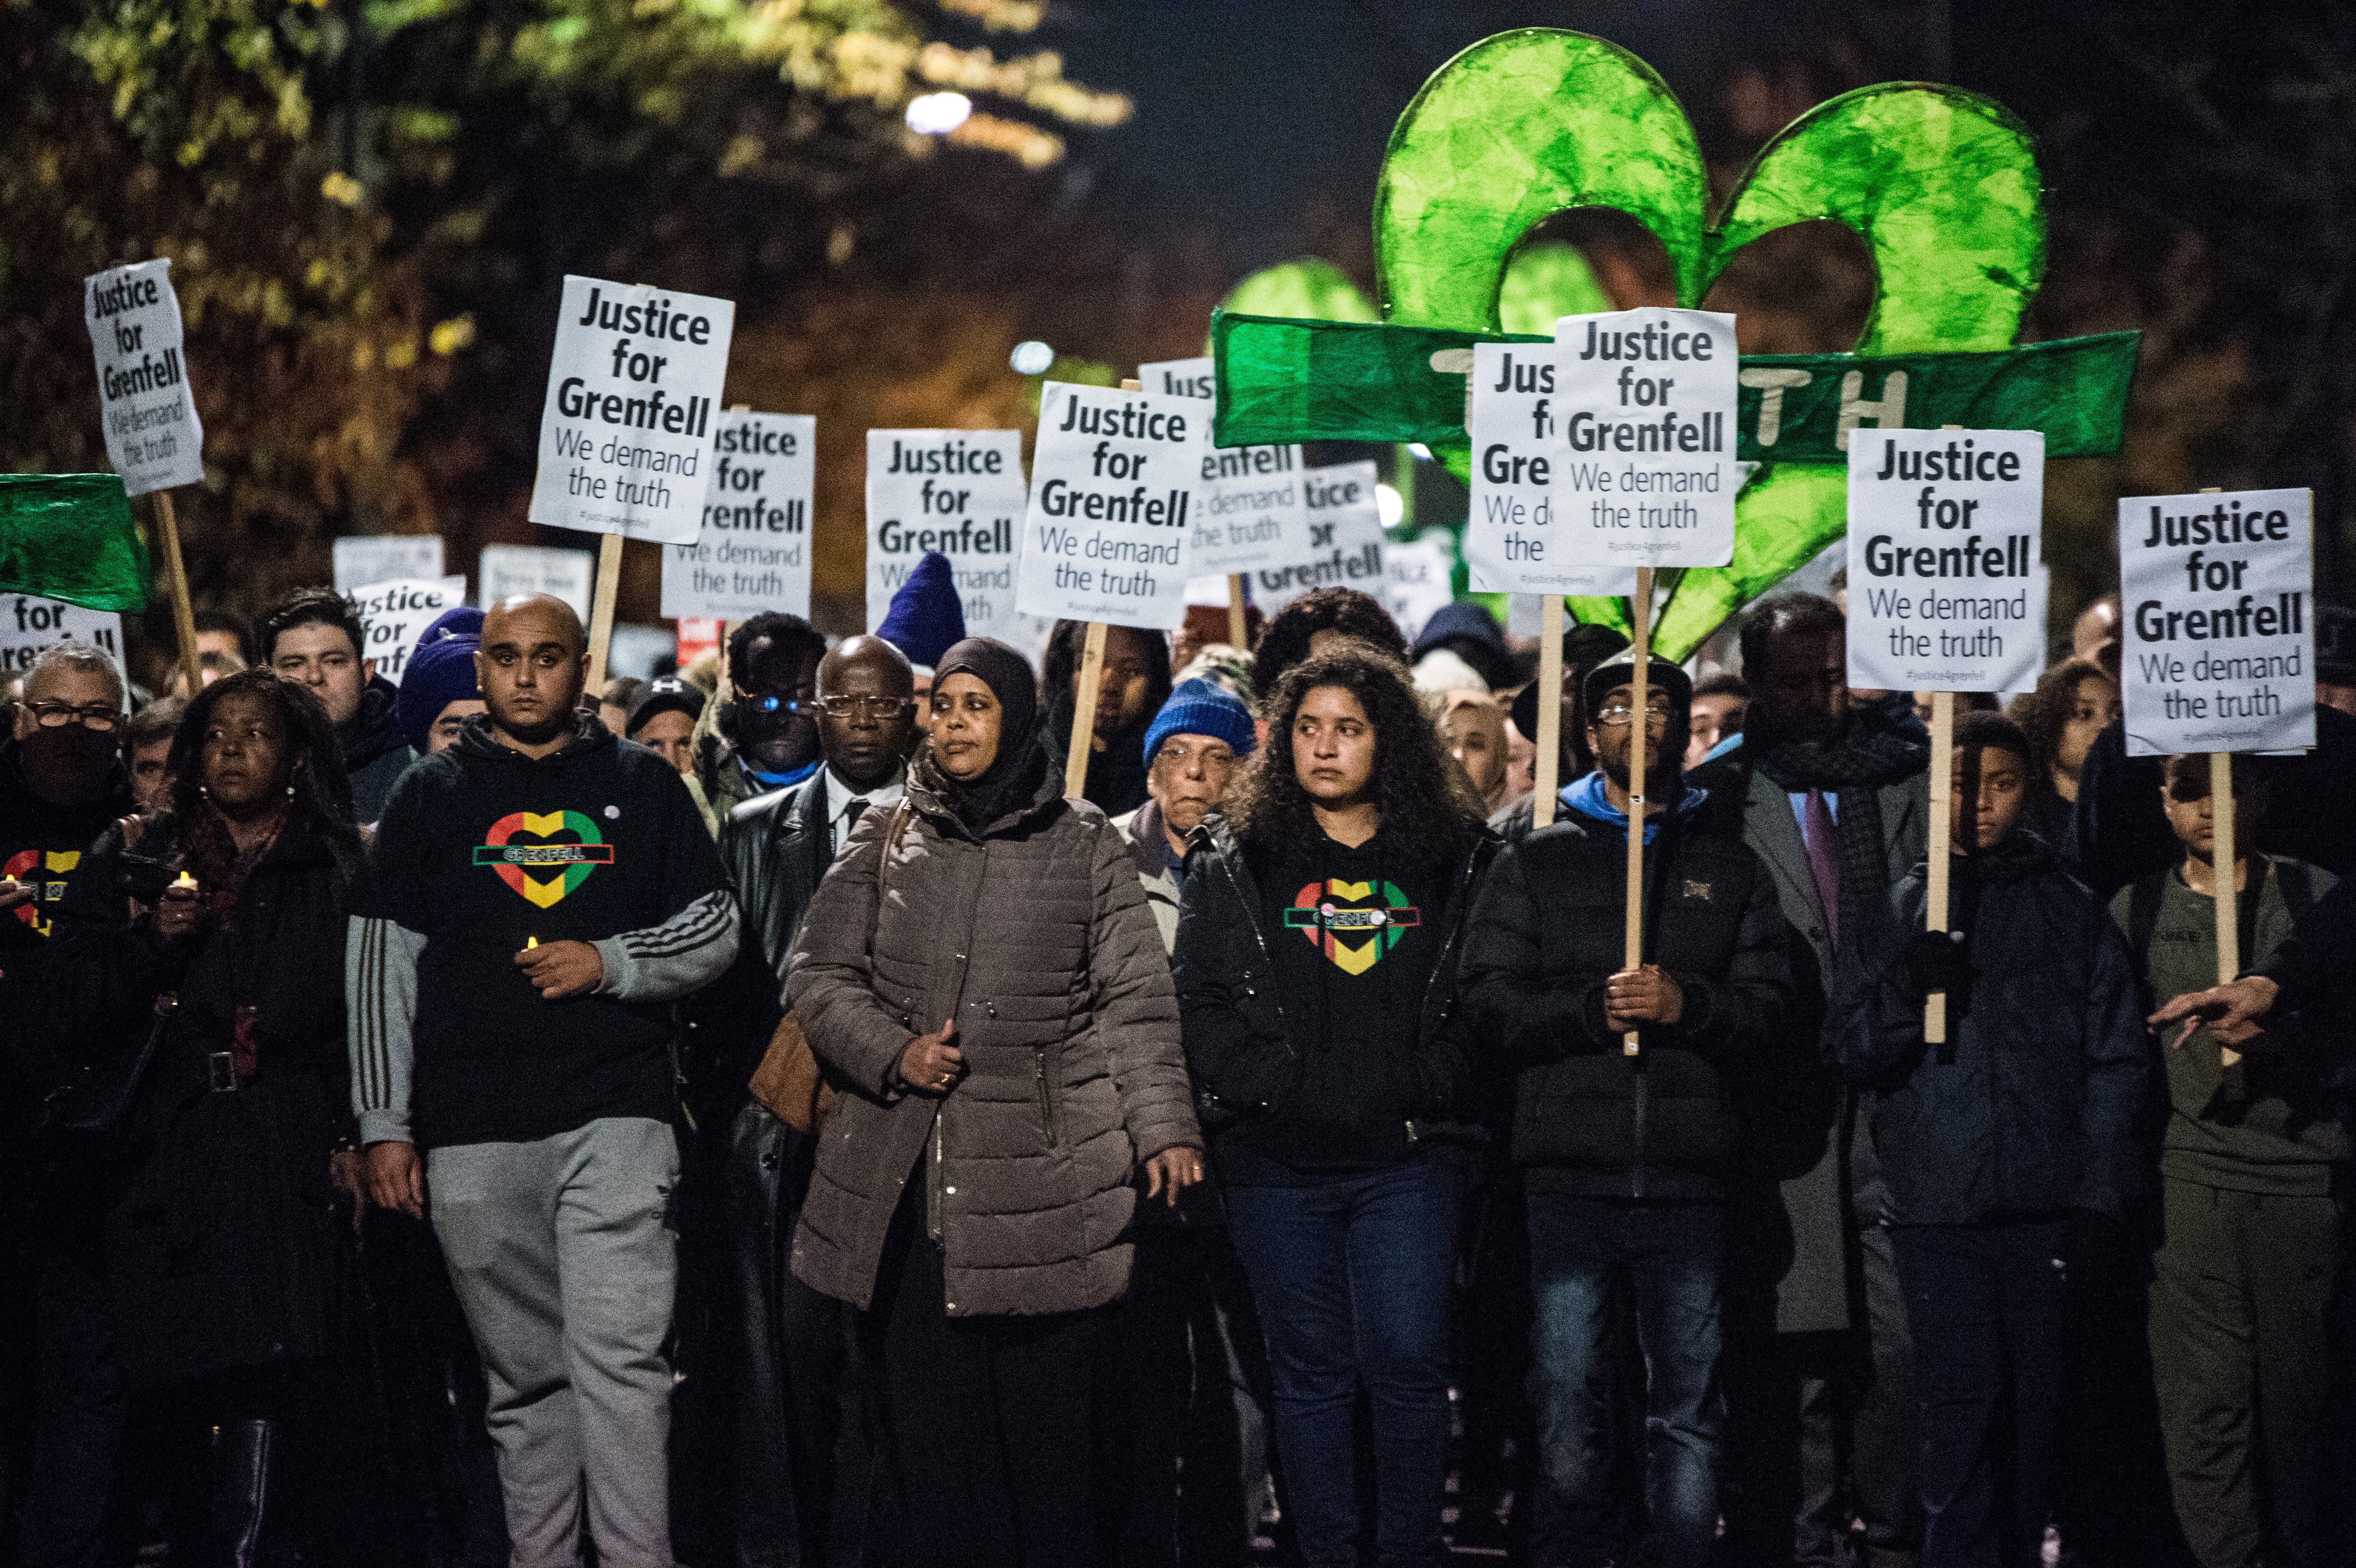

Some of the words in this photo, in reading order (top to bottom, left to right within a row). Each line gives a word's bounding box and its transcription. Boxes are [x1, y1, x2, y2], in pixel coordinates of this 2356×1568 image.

[95, 275, 158, 319] Justice
[580, 287, 711, 345] Justice
[115, 320, 142, 354] for
[1579, 321, 1714, 362] Justice
[104, 347, 180, 401] Grenfell
[612, 338, 667, 384] for
[1430, 347, 1908, 451] TTH
[1617, 366, 1675, 407] for
[558, 377, 710, 438] Grenfell
[1060, 394, 1188, 442] Justice
[1568, 411, 1724, 453] Grenfell
[556, 427, 593, 461] We
[600, 435, 699, 478] demand
[888, 440, 1003, 475] Justice
[1092, 441, 1148, 481] for
[1876, 439, 2021, 482] Justice
[569, 466, 606, 499] the
[615, 478, 671, 509] truth
[718, 458, 766, 492] for
[1571, 462, 1612, 493] We
[1620, 462, 1719, 493] demand
[702, 498, 805, 534] renfell
[921, 479, 971, 514] for
[1041, 479, 1191, 528] Grenfell
[1208, 481, 1296, 516] demand
[1485, 495, 1526, 525] We
[1592, 498, 1630, 529] the
[1638, 498, 1698, 529] truth
[1917, 486, 1980, 530] for
[878, 518, 1012, 555] Grenfell
[1227, 516, 1282, 545] truth
[2143, 500, 2290, 548] Justice
[716, 539, 802, 567] demand
[1039, 526, 1079, 556] We
[1085, 531, 1180, 566] demand
[1505, 532, 1544, 562] the
[1864, 534, 2030, 578] Grenfell
[693, 568, 725, 594] the
[733, 571, 783, 597] truth
[1055, 562, 1092, 591] the
[1100, 570, 1157, 597] truth
[2185, 550, 2249, 593] for
[14, 593, 66, 632] for
[1866, 588, 1911, 620] We
[1918, 588, 2026, 620] demand
[2135, 592, 2303, 643] Grenfell
[1889, 626, 1931, 658] the
[1939, 626, 2003, 658] truth
[2139, 653, 2184, 684] We
[2192, 645, 2301, 682] demand
[2163, 689, 2207, 720] the
[2216, 685, 2281, 718] truth
[502, 847, 585, 862] GRENFELL
